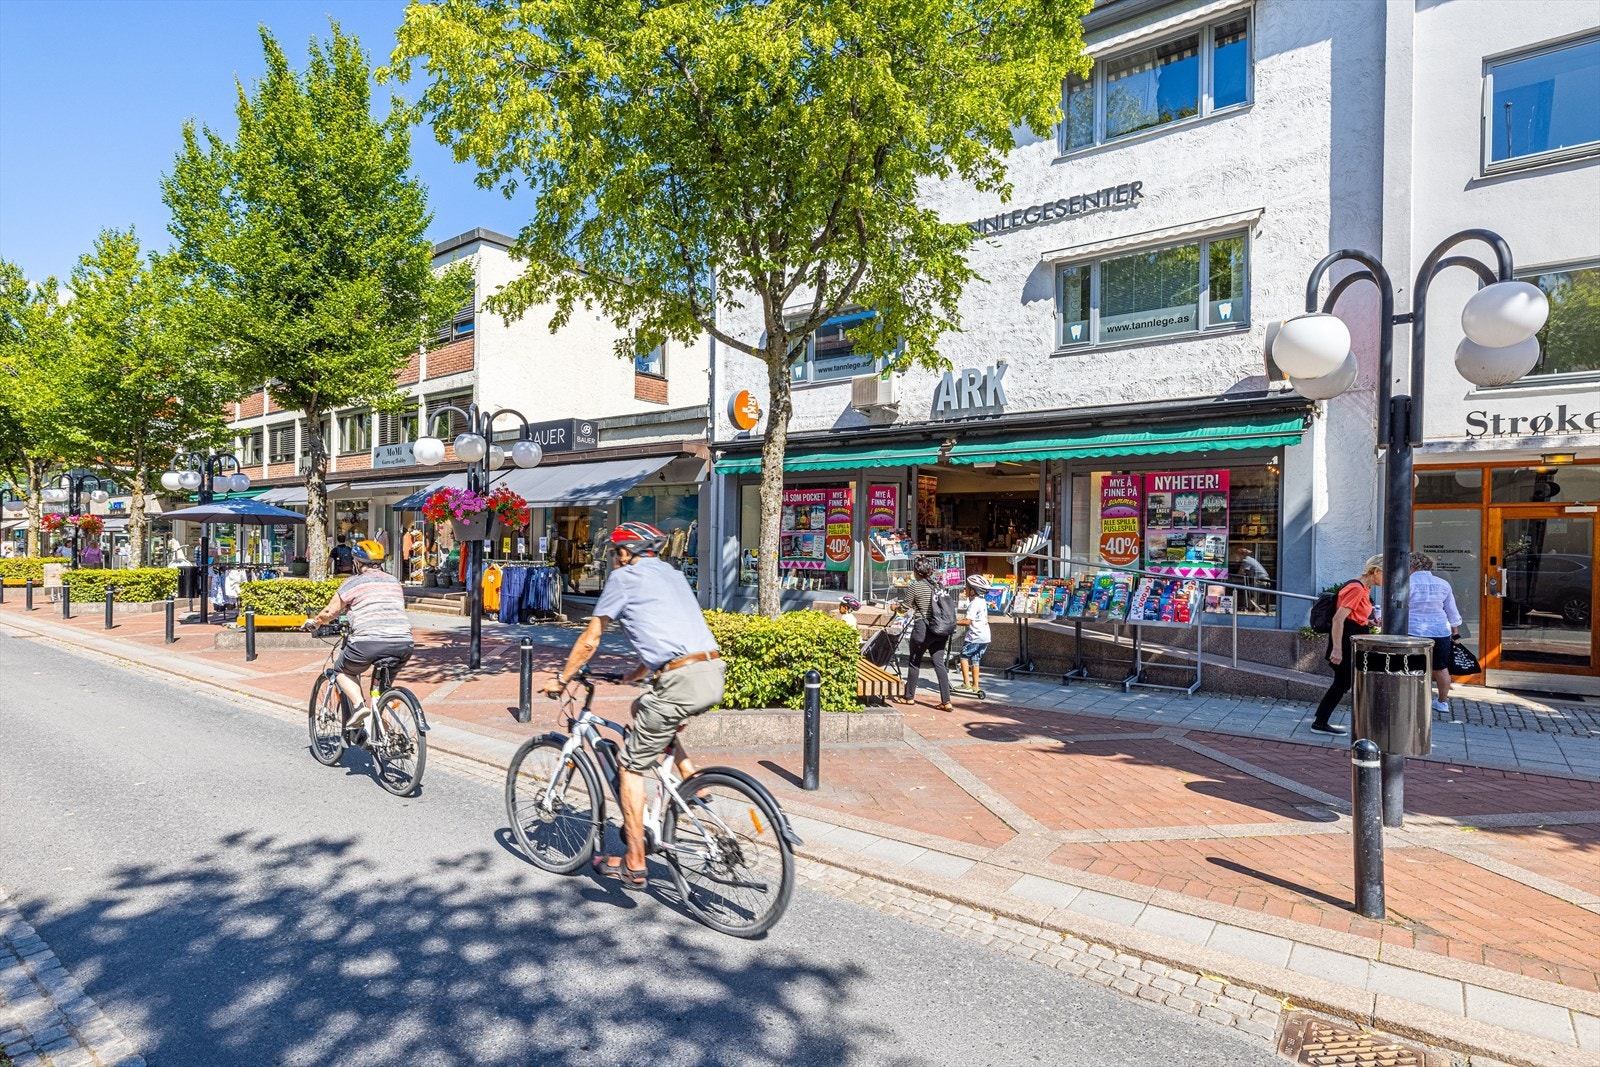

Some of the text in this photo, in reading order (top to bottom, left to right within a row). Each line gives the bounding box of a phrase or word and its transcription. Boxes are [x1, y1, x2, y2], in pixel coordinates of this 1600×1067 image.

[968, 180, 1144, 235] NNLEGESENTER
[1107, 315, 1190, 333] www.tannlege.as
[936, 363, 1009, 411] ARK
[576, 435, 596, 445] BAUER
[386, 446, 403, 457] MoMi
[1109, 475, 1133, 488] MYE Å
[1154, 474, 1219, 491] NYHETER!
[832, 491, 843, 499] MYE
[1103, 485, 1138, 497] FINNE PÅ
[789, 493, 803, 502] SOM
[802, 492, 826, 502] POCKET!
[828, 497, 851, 507] FINNE PÅ
[871, 498, 895, 507] FINNE PÅ
[1107, 498, 1138, 507] sommer
[1103, 524, 1137, 532] PUSLESPILL
[826, 538, 851, 554] -40%
[1100, 537, 1139, 555] -40%
